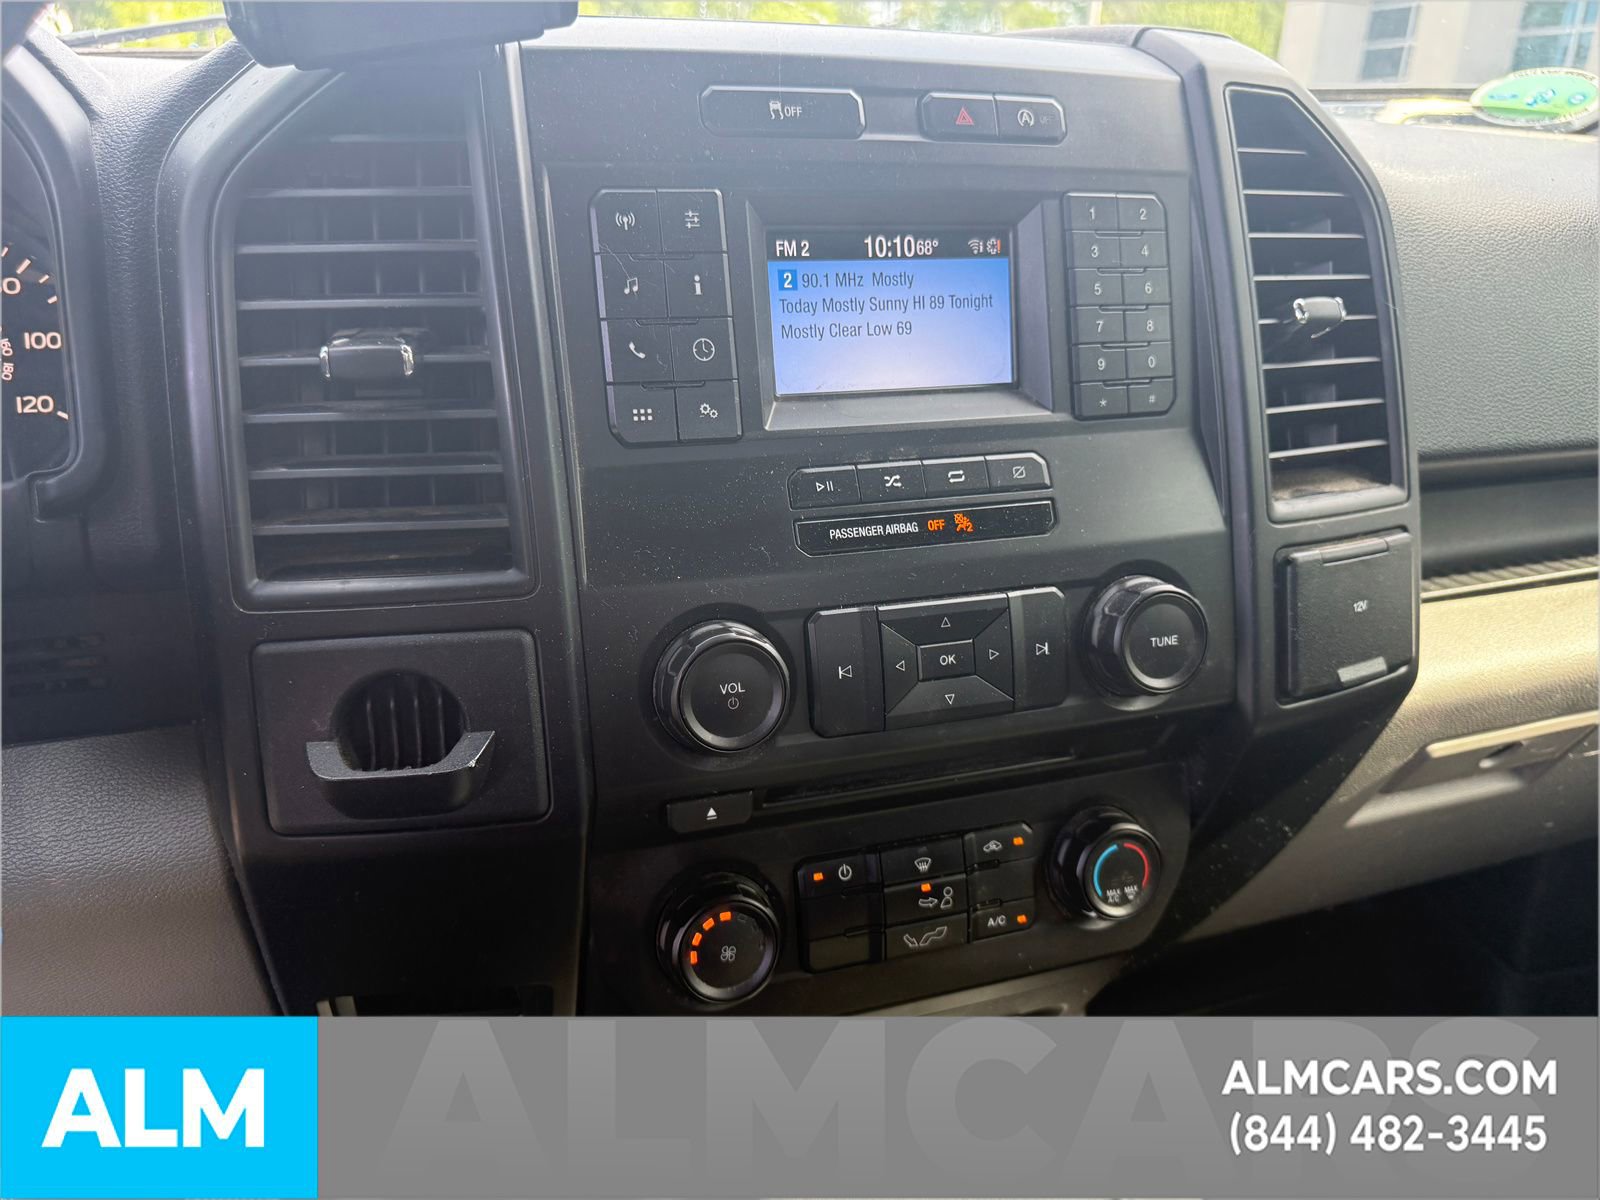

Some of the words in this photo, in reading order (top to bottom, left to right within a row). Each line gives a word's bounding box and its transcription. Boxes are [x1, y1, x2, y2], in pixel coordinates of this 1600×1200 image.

[784, 105, 802, 118] OFF
[1089, 207, 1095, 220] 1
[1139, 207, 1147, 220] 2
[775, 240, 797, 257] FM
[801, 240, 810, 257] 2
[864, 234, 915, 258] 10:10
[1091, 245, 1099, 258] 3
[1141, 245, 1149, 257] 4
[0, 277, 21, 295] 0
[783, 273, 793, 288] 2
[802, 273, 830, 288] 90.1
[835, 272, 864, 287] MHz
[872, 271, 914, 288] Mostly
[1094, 283, 1102, 295] 5
[1144, 282, 1153, 294] 6
[780, 298, 818, 316] Today
[822, 297, 865, 315] Mostly
[869, 296, 908, 314] Sunny
[929, 295, 945, 308] 89
[948, 293, 993, 312] Tonight
[781, 323, 824, 341] Mostly
[829, 322, 862, 337] Clear
[866, 321, 892, 336] Low
[896, 321, 912, 335] 69
[1096, 320, 1104, 332] 7
[1146, 319, 1154, 331] 8
[23, 331, 62, 350] 100
[1097, 358, 1105, 370] 9
[1148, 356, 1156, 368] 0
[1, 362, 14, 381] 180
[16, 395, 55, 414] 120
[829, 525, 884, 540] PASSENGER
[885, 522, 919, 535] AIRBAG
[927, 519, 945, 531] OFF
[1149, 634, 1179, 648] TUNE
[939, 653, 957, 665] OK
[719, 682, 746, 695] VOL
[987, 914, 1007, 927] A/C
